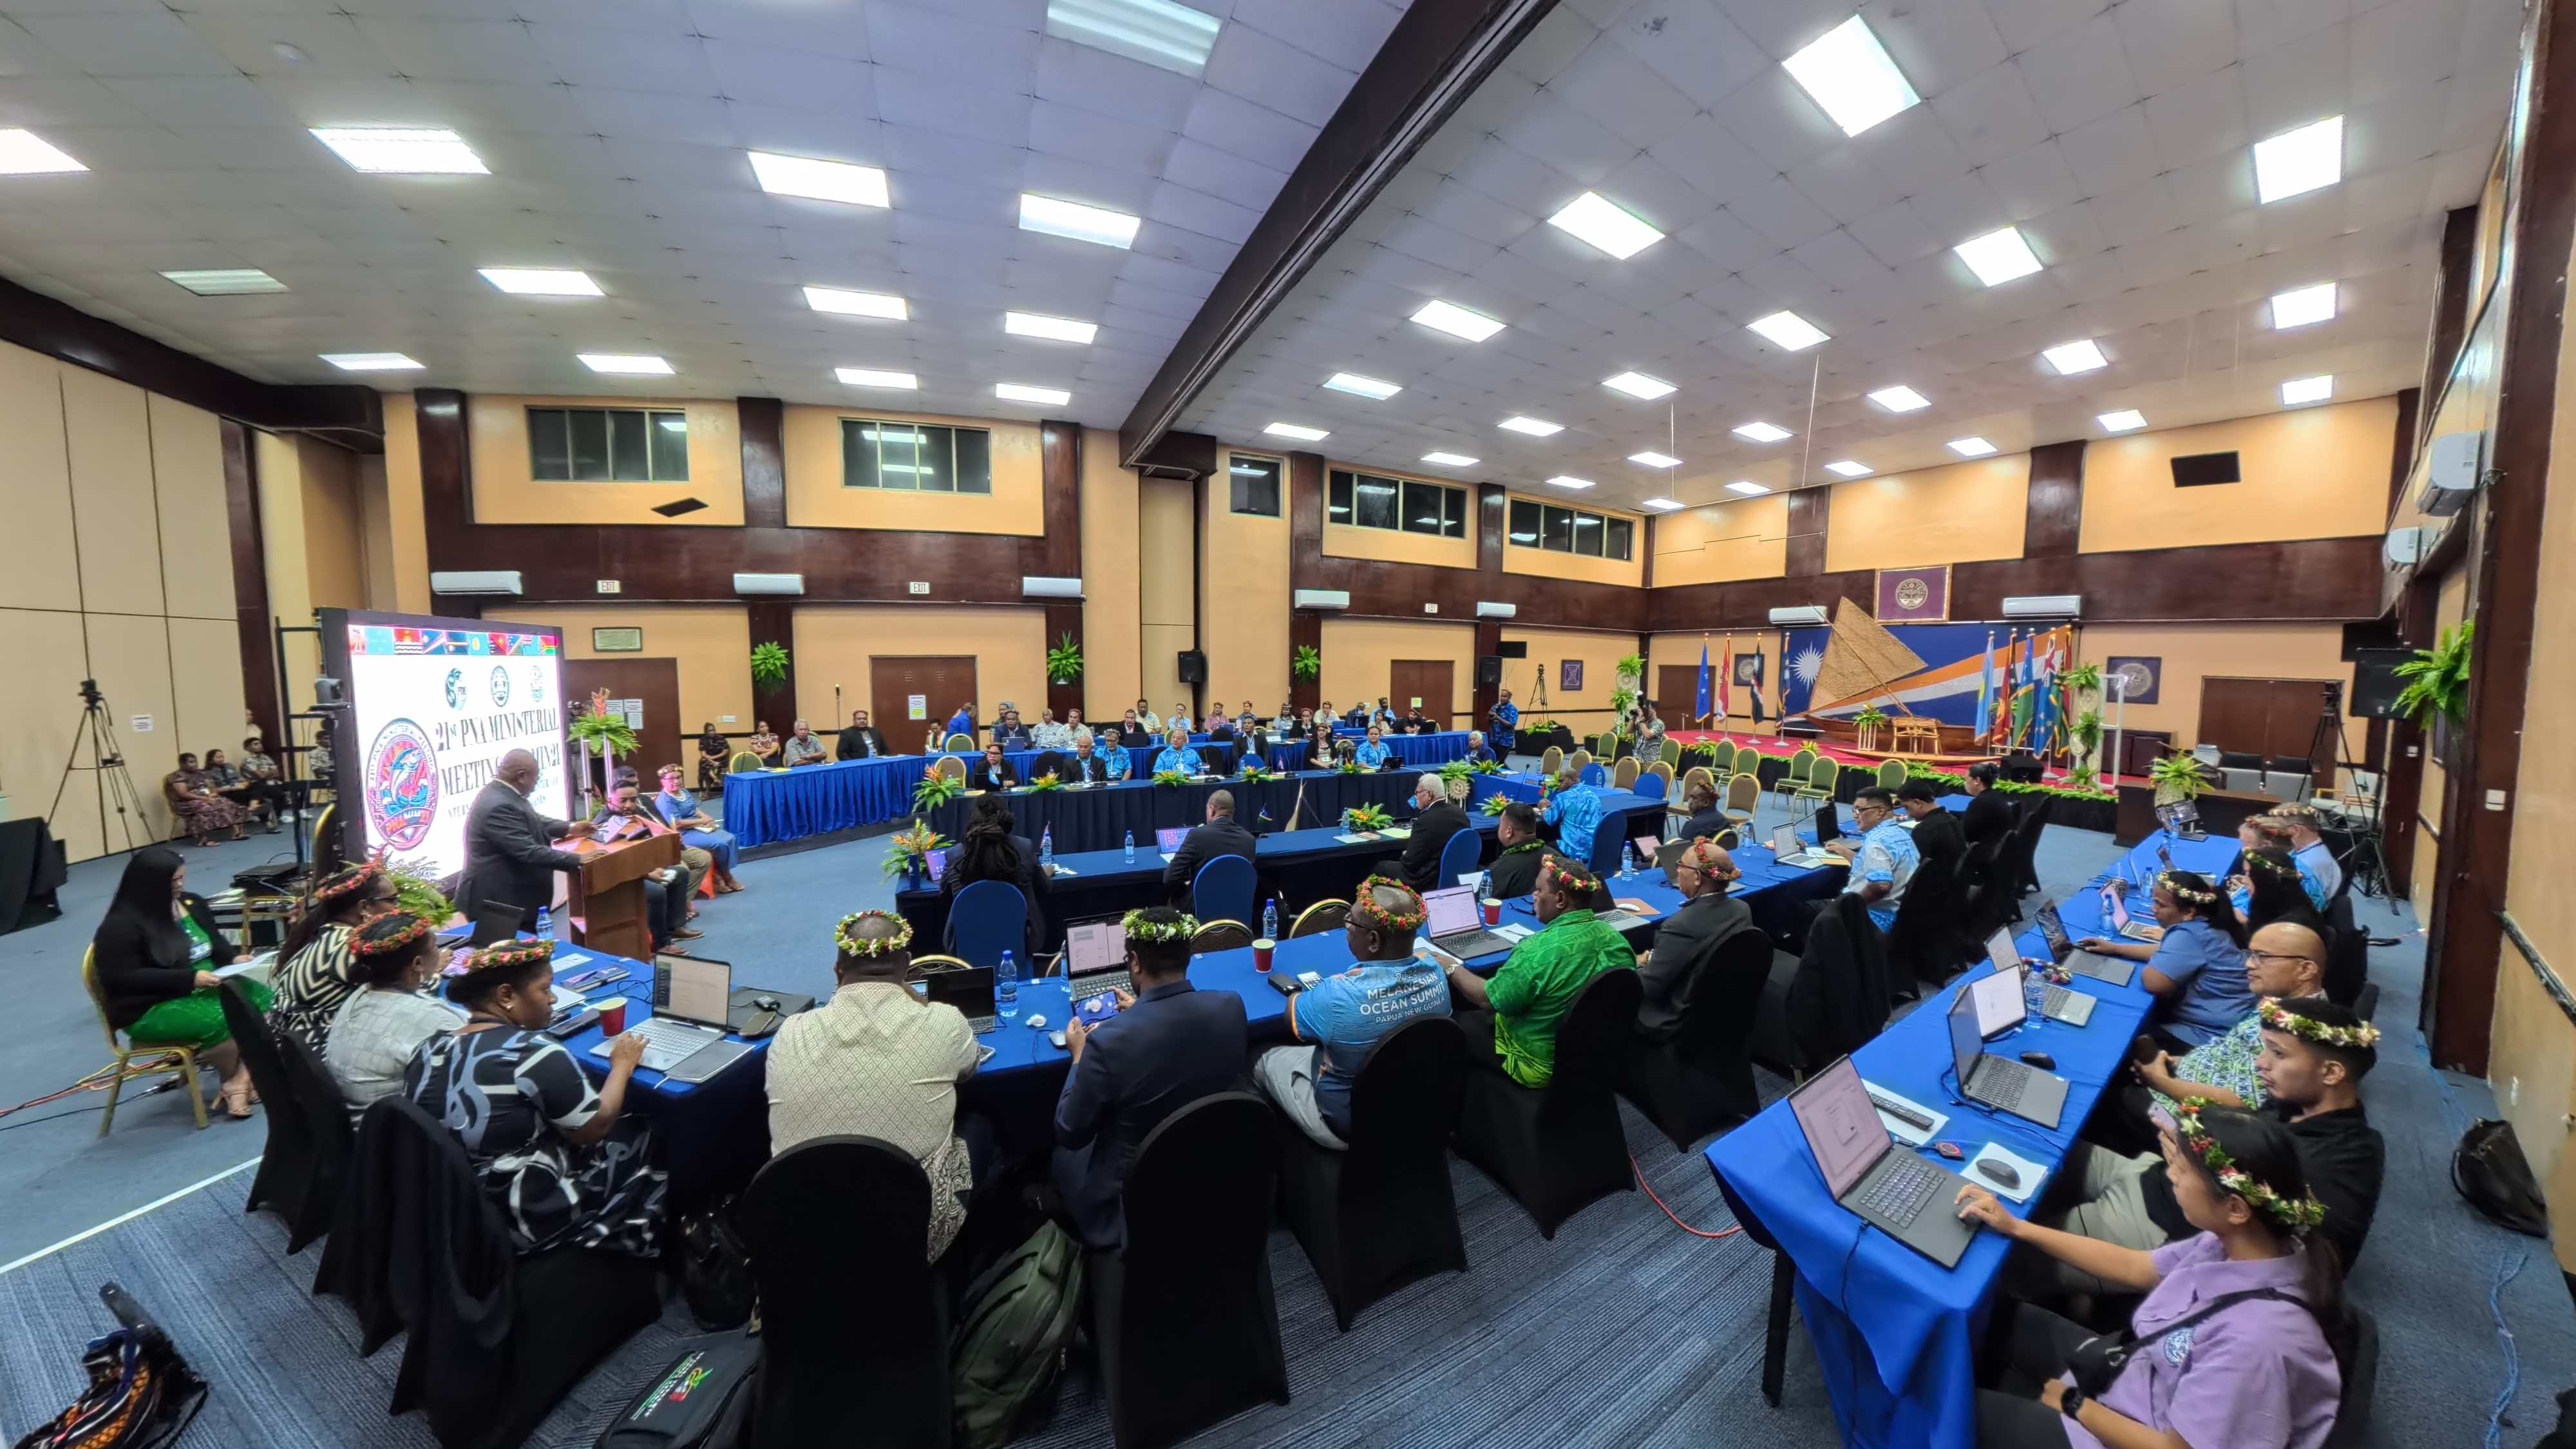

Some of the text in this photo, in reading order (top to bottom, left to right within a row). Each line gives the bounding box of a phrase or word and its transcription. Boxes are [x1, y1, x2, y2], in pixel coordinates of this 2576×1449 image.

[601, 582, 615, 591] EXIT
[914, 583, 926, 592] EXIT
[460, 717, 488, 747] PNA
[488, 707, 559, 743] MINISTERIAL
[1359, 981, 1446, 1015] OCEAN SUMMIT
[1367, 972, 1438, 1000] MELANESIAN
[1376, 996, 1446, 1024] PAPUA NEW GUINEA
